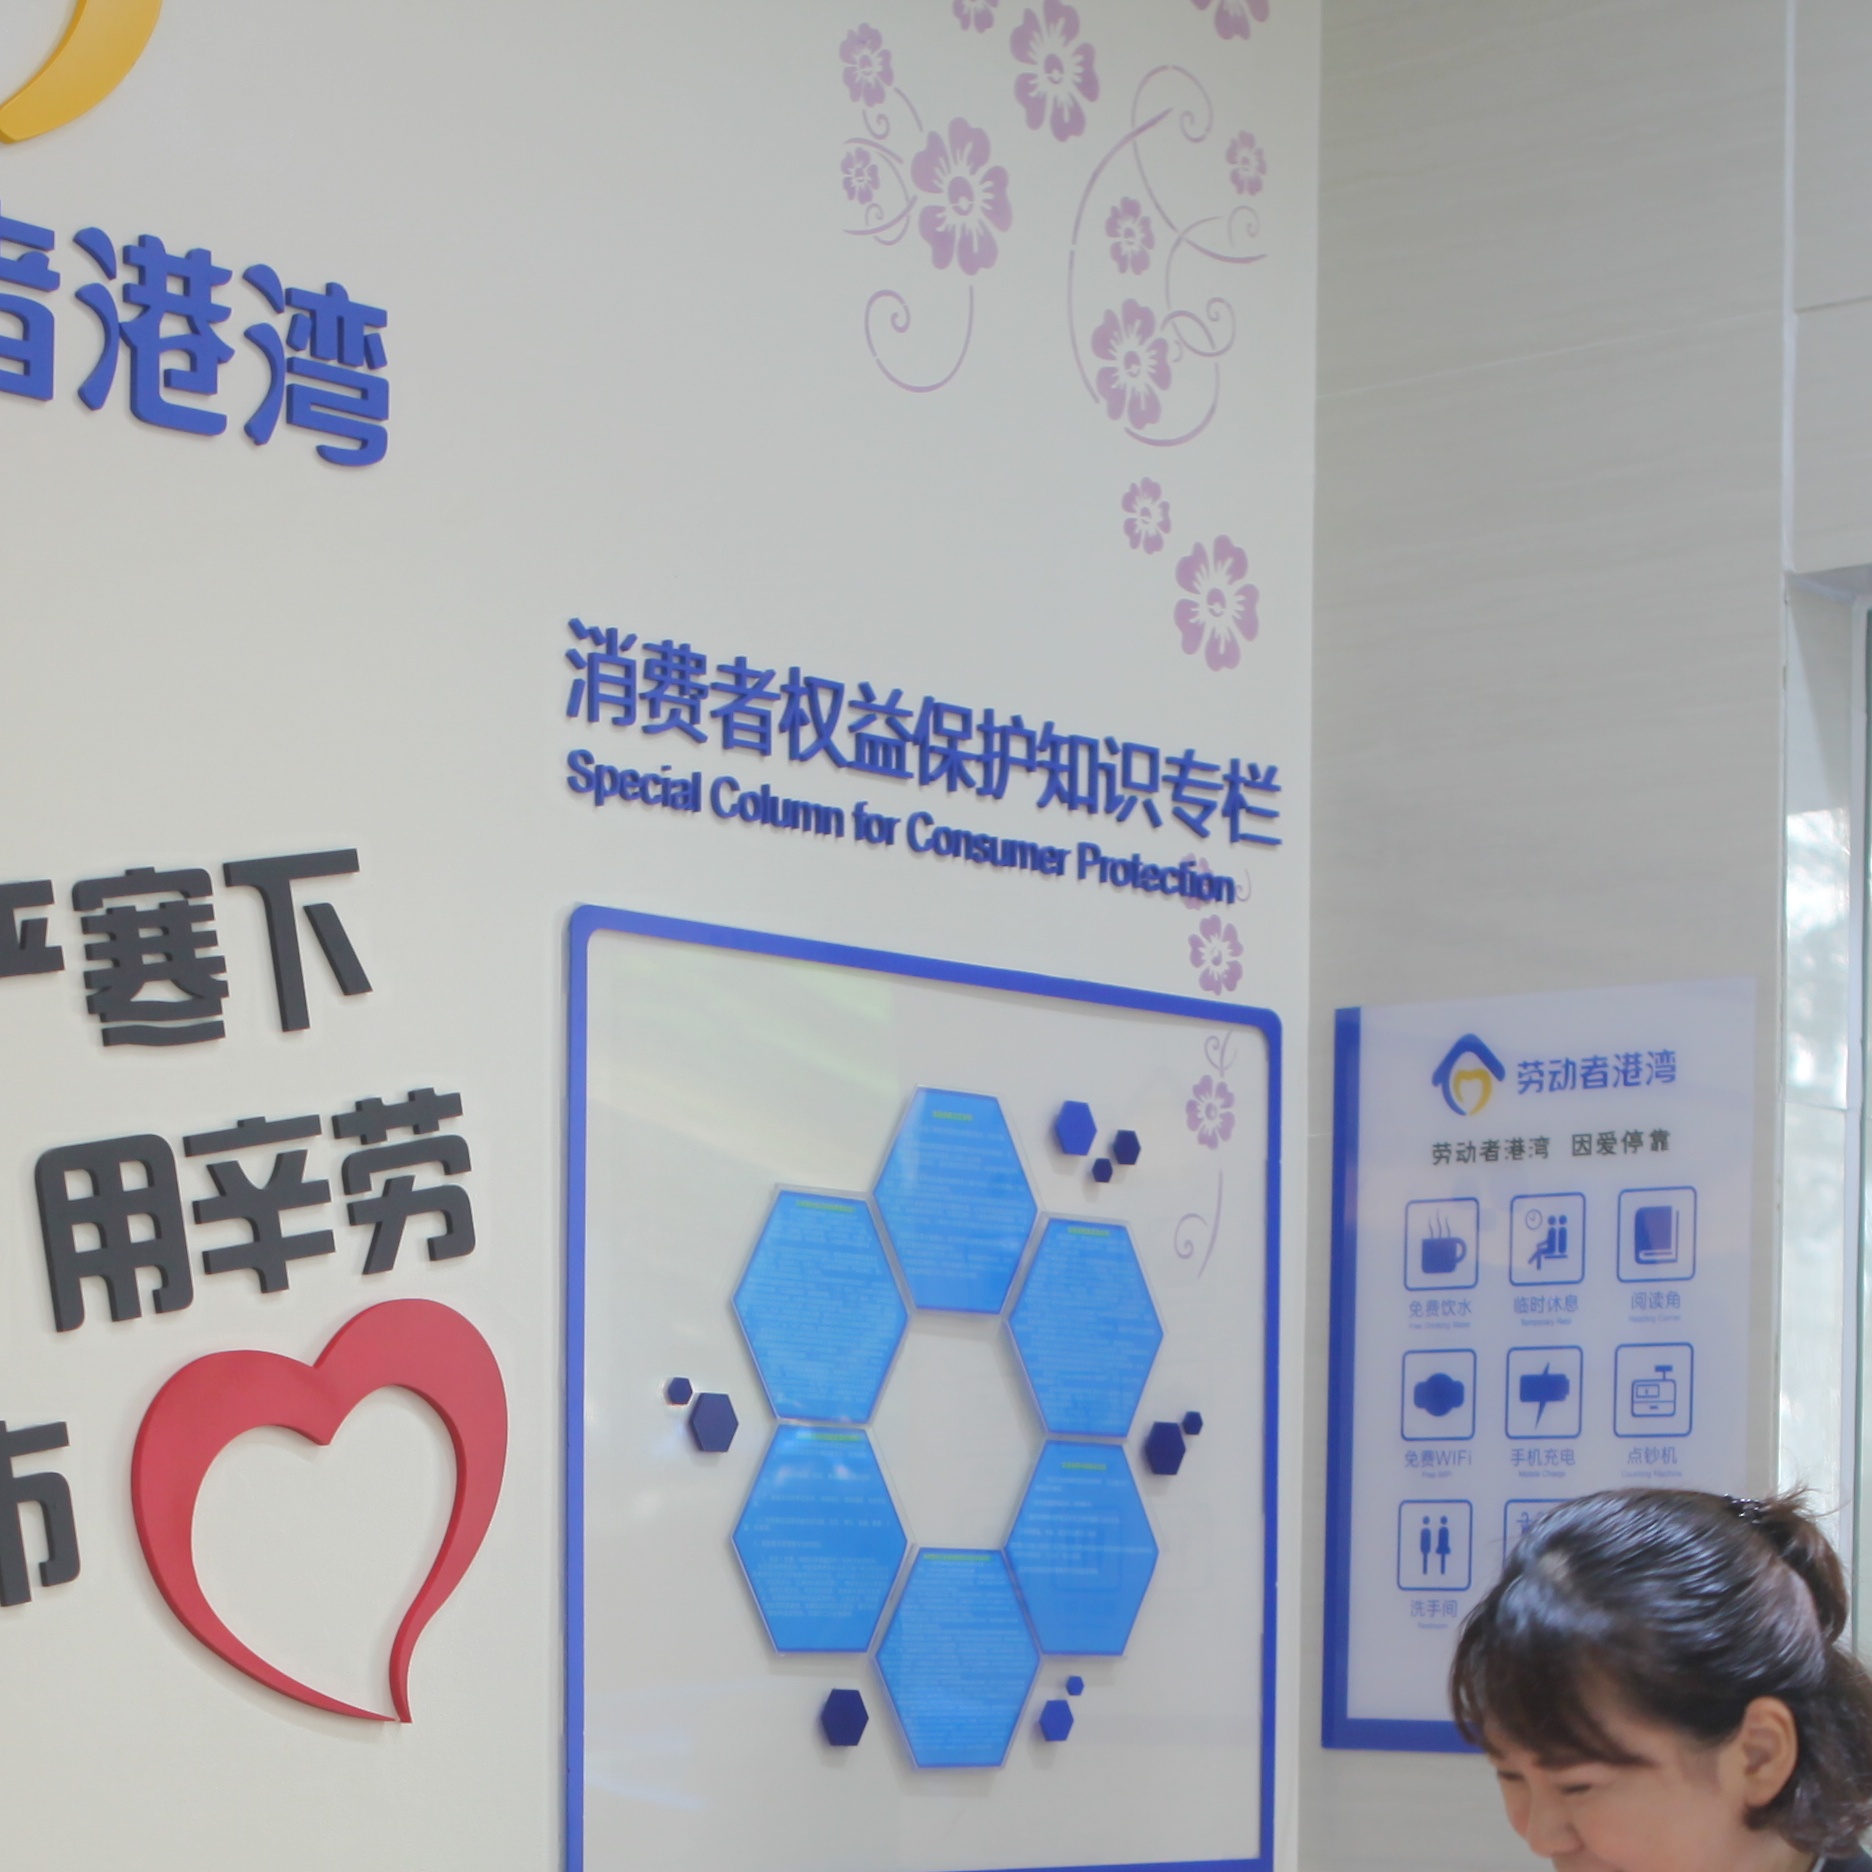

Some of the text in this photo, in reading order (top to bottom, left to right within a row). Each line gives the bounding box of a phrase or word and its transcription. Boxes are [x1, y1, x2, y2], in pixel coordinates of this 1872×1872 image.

[565, 617, 1283, 848] 消费者权益保护知识专栏
[566, 749, 1236, 905] Special Column for Consumer Protection
[1517, 1050, 1677, 1095] 劳动者港湾
[1432, 1128, 1671, 1166] 劳动者港湾 因爱停靠
[33, 1086, 477, 1333] 用辛劳
[1408, 1299, 1472, 1318] 免费饮水
[1513, 1294, 1579, 1314] 临时休息
[1631, 1291, 1681, 1311] 阅读角
[1510, 1449, 1576, 1467] 手机充电
[1627, 1446, 1678, 1465] 点钞机
[1410, 1599, 1458, 1618] 洗手间
